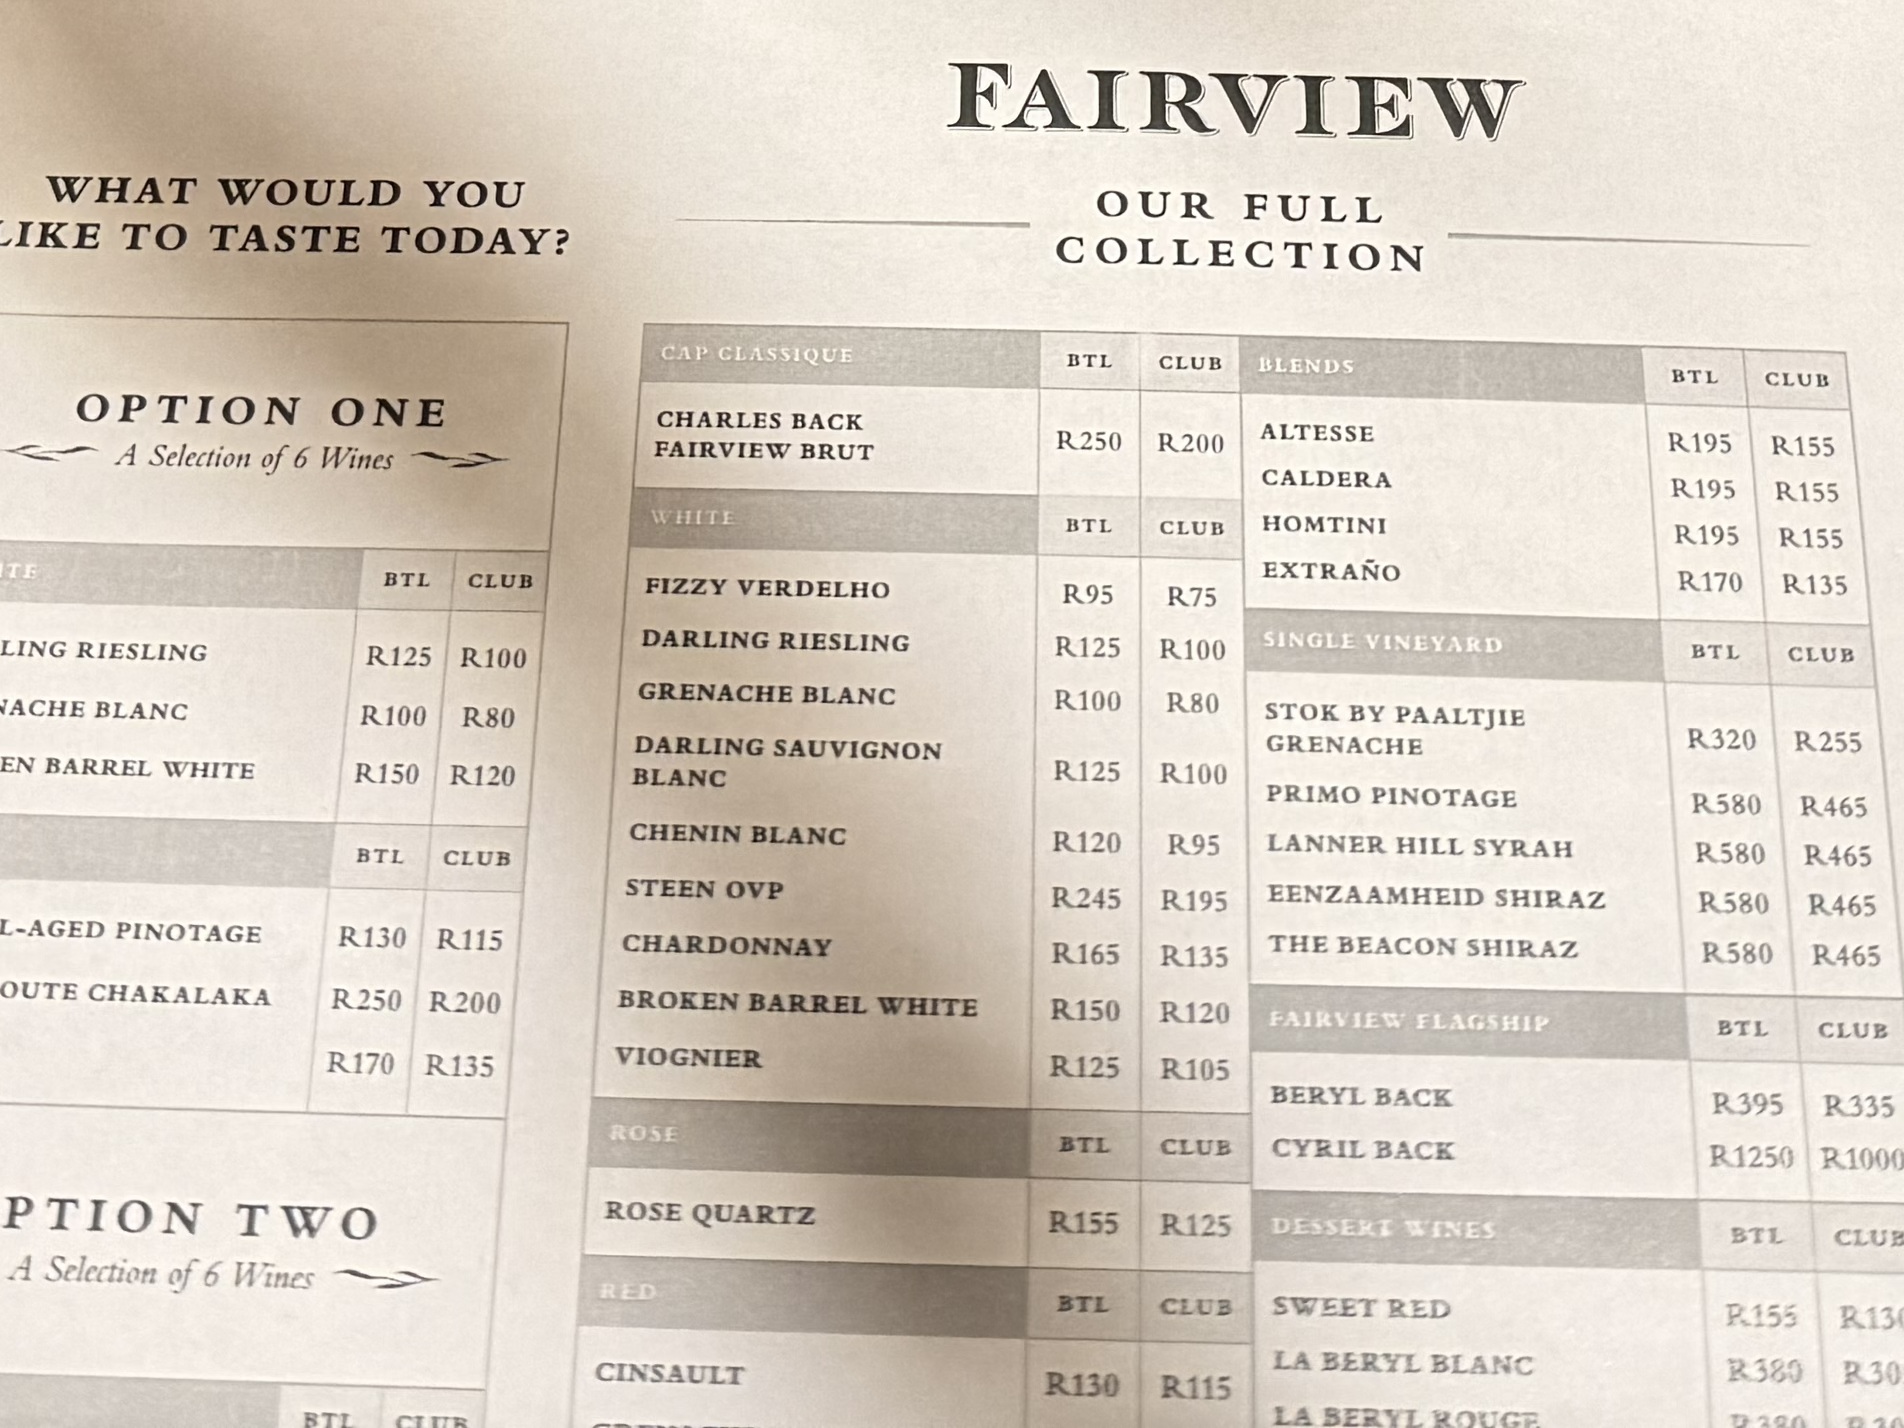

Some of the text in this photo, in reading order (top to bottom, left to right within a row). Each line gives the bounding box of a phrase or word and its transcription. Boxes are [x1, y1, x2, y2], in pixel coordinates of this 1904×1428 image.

[946, 62, 1527, 143] FAIRVIEW
[45, 175, 526, 209] WHAT WOULD YOU
[1096, 190, 1383, 224] OUR FULL
[121, 222, 188, 251] TO
[208, 224, 361, 253] TASTE
[380, 225, 570, 256] TODAY?
[1055, 235, 1424, 273] COLLECTION
[661, 343, 1222, 371] CAP CLASSIQUE BTL CLUB
[1257, 356, 1830, 388] BLENDS BTL CLUB
[76, 393, 445, 428] OPTION ONE
[656, 410, 864, 431] CHARLES BACK
[654, 440, 875, 461] FAIRVIEW BRUT
[1056, 430, 1224, 454] R250 R200
[1260, 422, 1835, 458] ALTESSE R195 R155
[113, 443, 395, 477] A Selection of 6 Wines
[1261, 468, 1840, 504] CALDERA R195 R155
[1262, 514, 1844, 550] HOMTINI R195 R155
[383, 571, 431, 588] BTL
[468, 573, 533, 589] CLUB
[645, 577, 1217, 608] FIZZY VERDELHO R95 R75
[1262, 558, 1848, 596] EXTRAÑO R170 R135
[75, 641, 208, 662] RIESLING
[365, 645, 432, 667] R125
[460, 646, 527, 669] R100
[1263, 630, 1855, 664] SINGLE VINEYARD BTL CLUB
[93, 700, 189, 721] BLANC
[360, 704, 427, 727] R100
[461, 706, 516, 729] R80
[1264, 702, 1526, 732] STOK BY PAALTJIE
[634, 735, 942, 761] DARLING SAUVIGNON
[1266, 734, 1424, 756] GRENACHE
[1687, 727, 1863, 754] R320 R255
[44, 757, 152, 777] BARREL
[162, 760, 255, 780] WHITE
[354, 762, 420, 785] R150
[449, 764, 516, 787] R120
[631, 767, 727, 788] BLANC
[1054, 759, 1228, 786] R125 R100
[1266, 784, 1868, 819] PRIMO PINOTAGE R580 R465
[1267, 883, 1877, 918] EENZAAMHEID SHIRAZ R580 R465
[115, 921, 262, 944] PINOTAGE
[338, 925, 407, 949] R130
[436, 927, 503, 952] R115
[87, 983, 272, 1007] CHAKALAKA
[331, 987, 402, 1012] R250
[428, 990, 502, 1015] R200
[326, 1050, 395, 1076] R170
[424, 1053, 494, 1078] R135
[1270, 1085, 1896, 1119] BERYL BACK R395 R335
[235, 1203, 378, 1241] TWO
[603, 1200, 1233, 1238] ROSE QUARTZ R155 R125
[1272, 1295, 1452, 1320] SWEET RED
